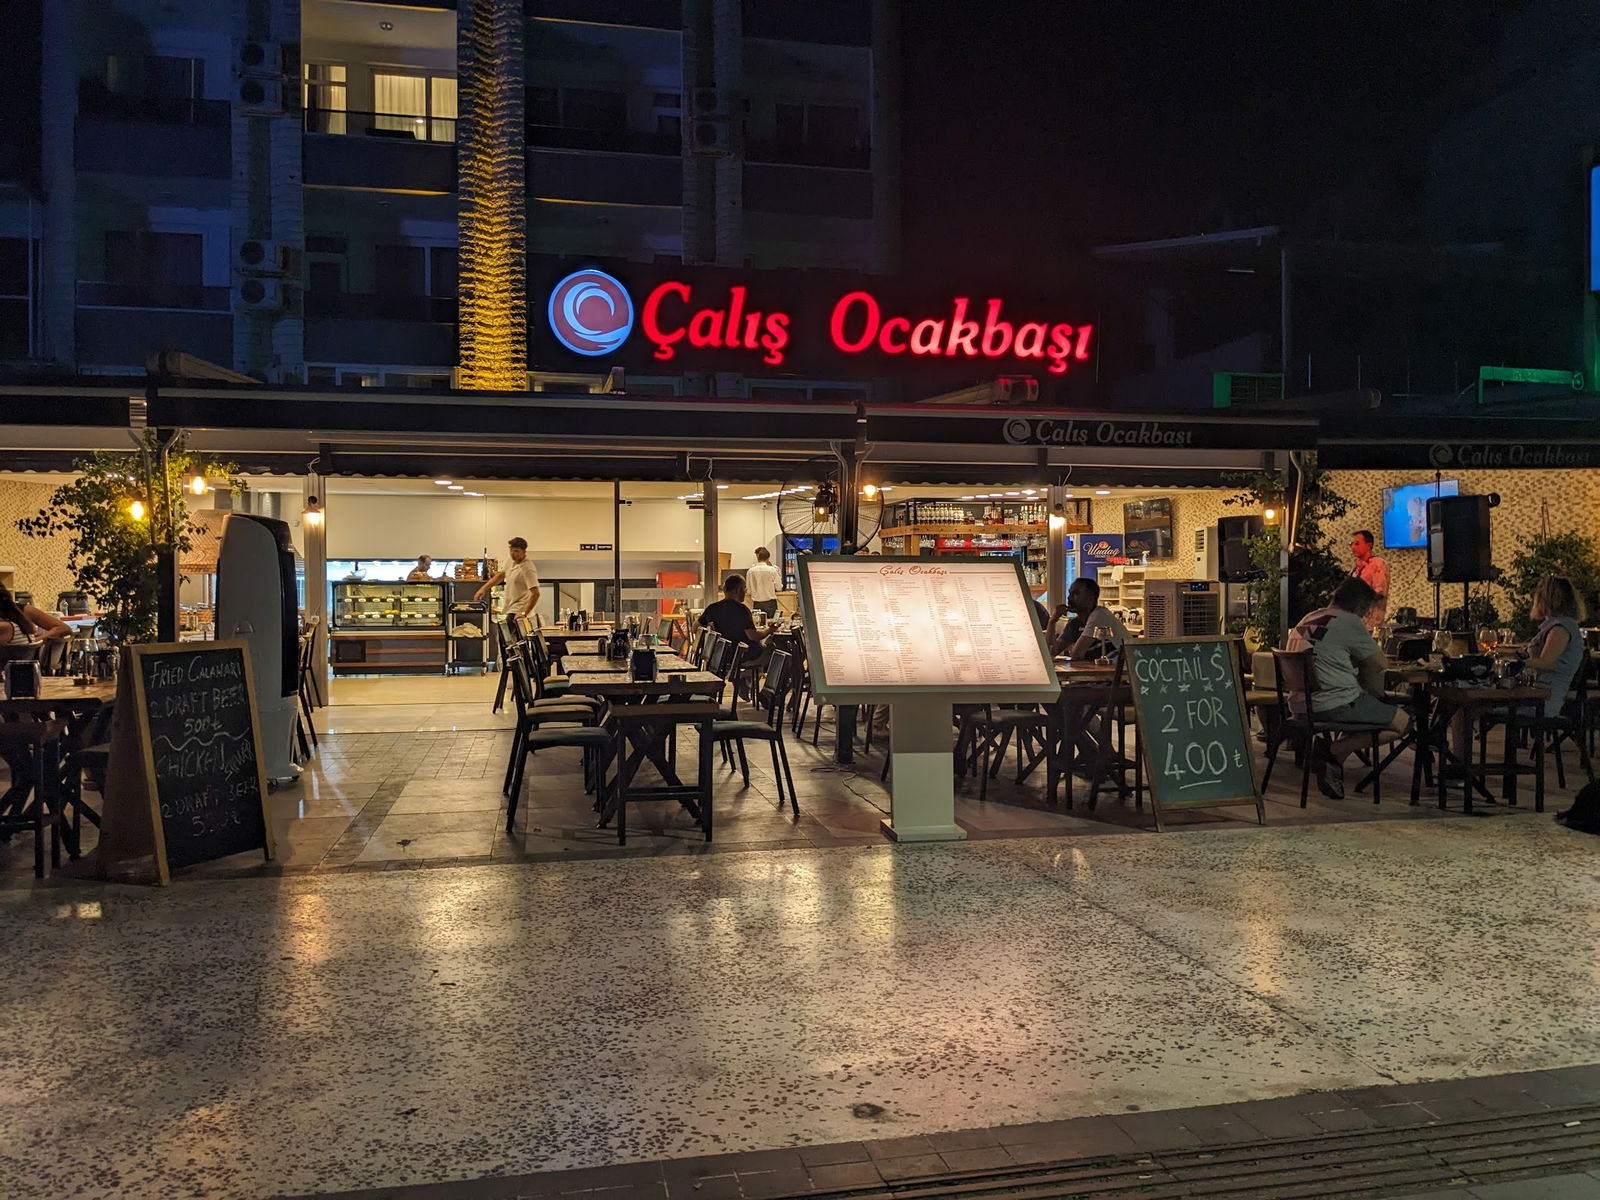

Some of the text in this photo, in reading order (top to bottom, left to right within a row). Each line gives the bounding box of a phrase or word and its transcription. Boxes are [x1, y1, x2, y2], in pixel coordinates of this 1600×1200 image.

[642, 280, 1093, 375] Çalış Ocakbaşı
[1035, 419, 1192, 447] Çalış Ocakbaşı
[149, 660, 184, 689] FRIED
[1160, 696, 1229, 734] 2 FOR
